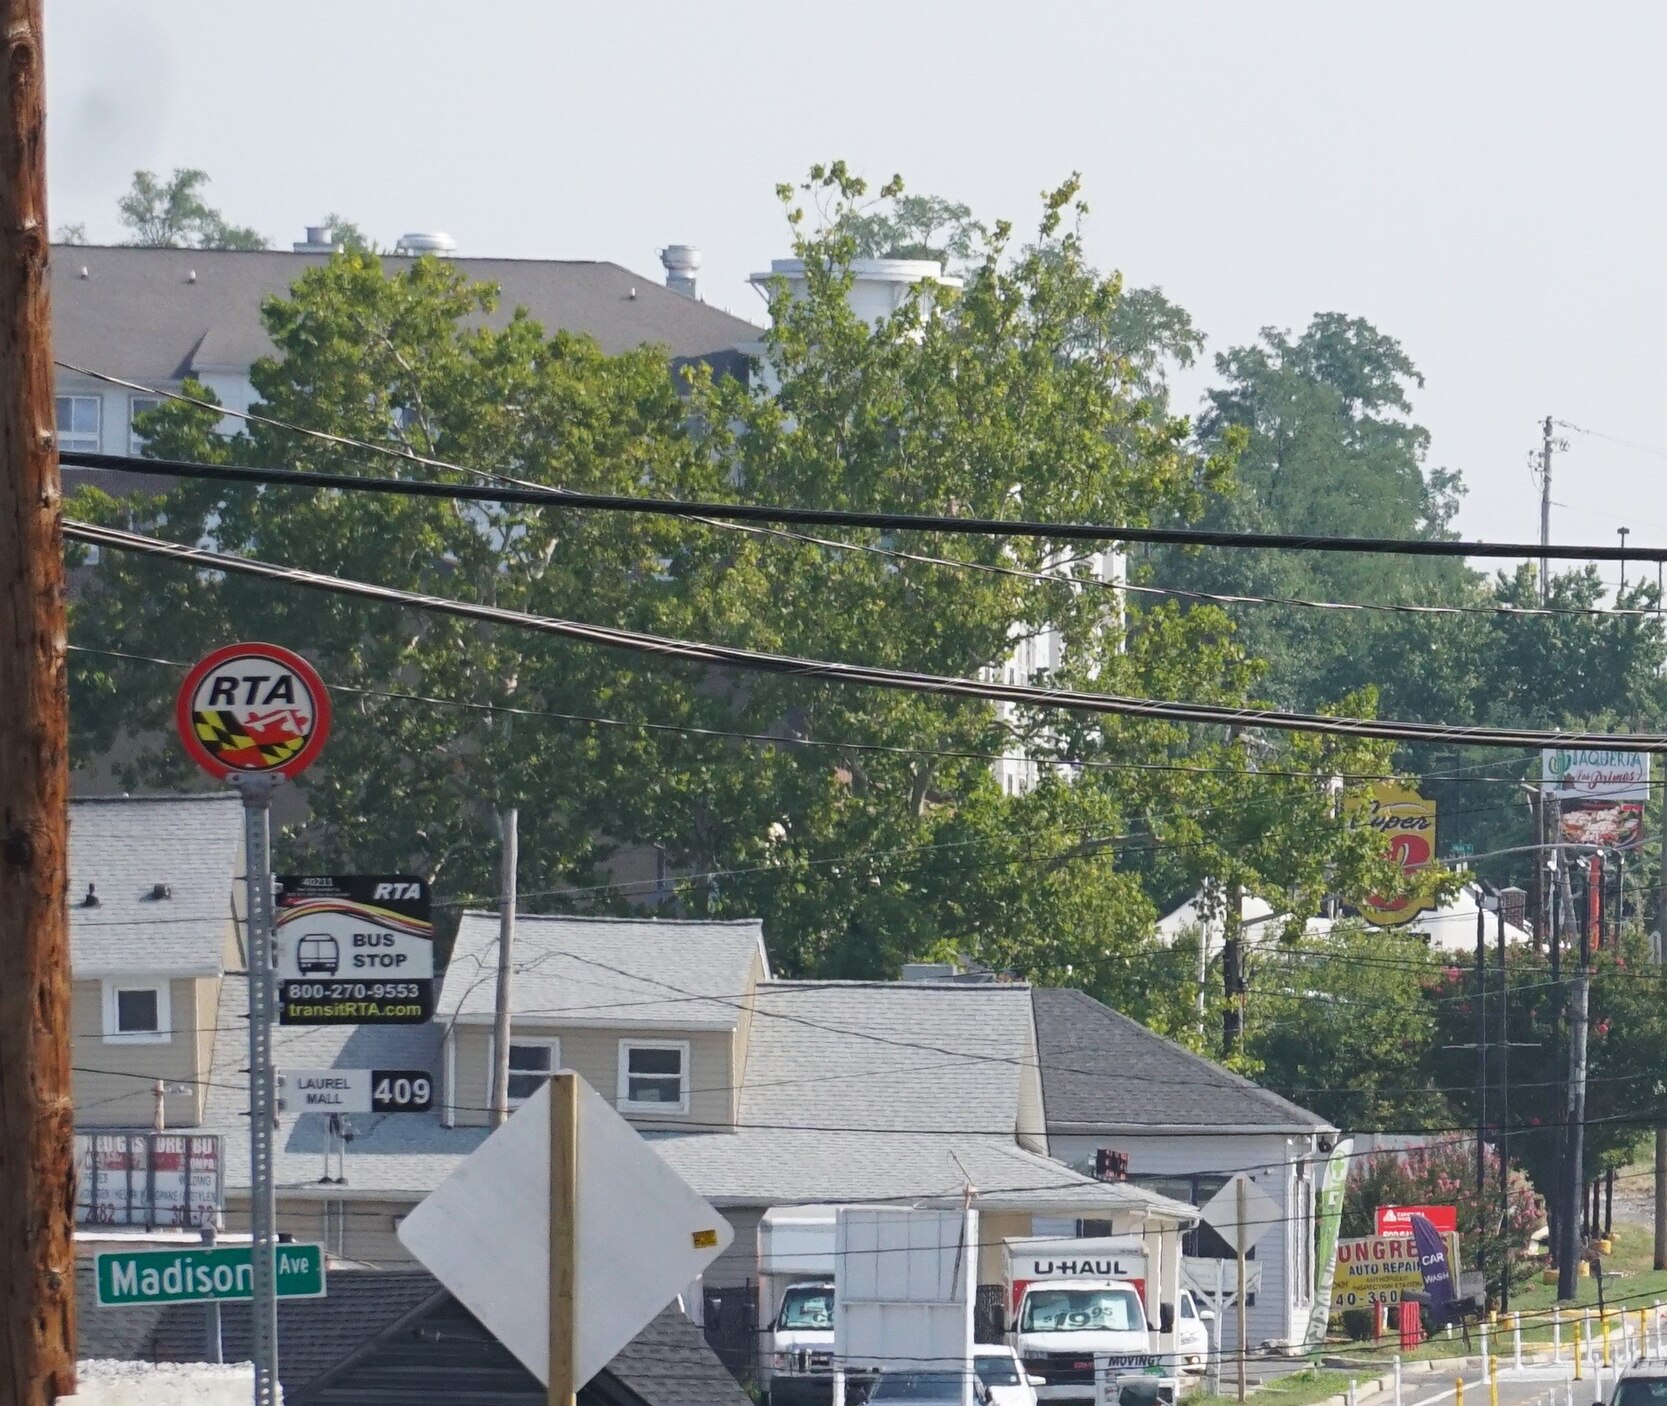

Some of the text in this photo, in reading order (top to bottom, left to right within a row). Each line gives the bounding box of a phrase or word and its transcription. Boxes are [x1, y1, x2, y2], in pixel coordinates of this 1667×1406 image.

[208, 674, 296, 706] RTA
[302, 877, 334, 887] 40211
[374, 882, 421, 900] RTA
[353, 933, 396, 947] BUS
[353, 953, 407, 968] STOP
[289, 983, 420, 999] 800-270-9553
[289, 1002, 422, 1017] transitRTA.com
[298, 1078, 351, 1090] LAUREL
[374, 1078, 431, 1105] 409
[305, 1093, 344, 1105] MALL
[1422, 1252, 1445, 1266] CAR
[111, 1253, 310, 1297] Madison Ave
[1034, 1260, 1128, 1275] U-HAUL
[1350, 1263, 1379, 1276] AUTO
[1424, 1272, 1450, 1284] WASH
